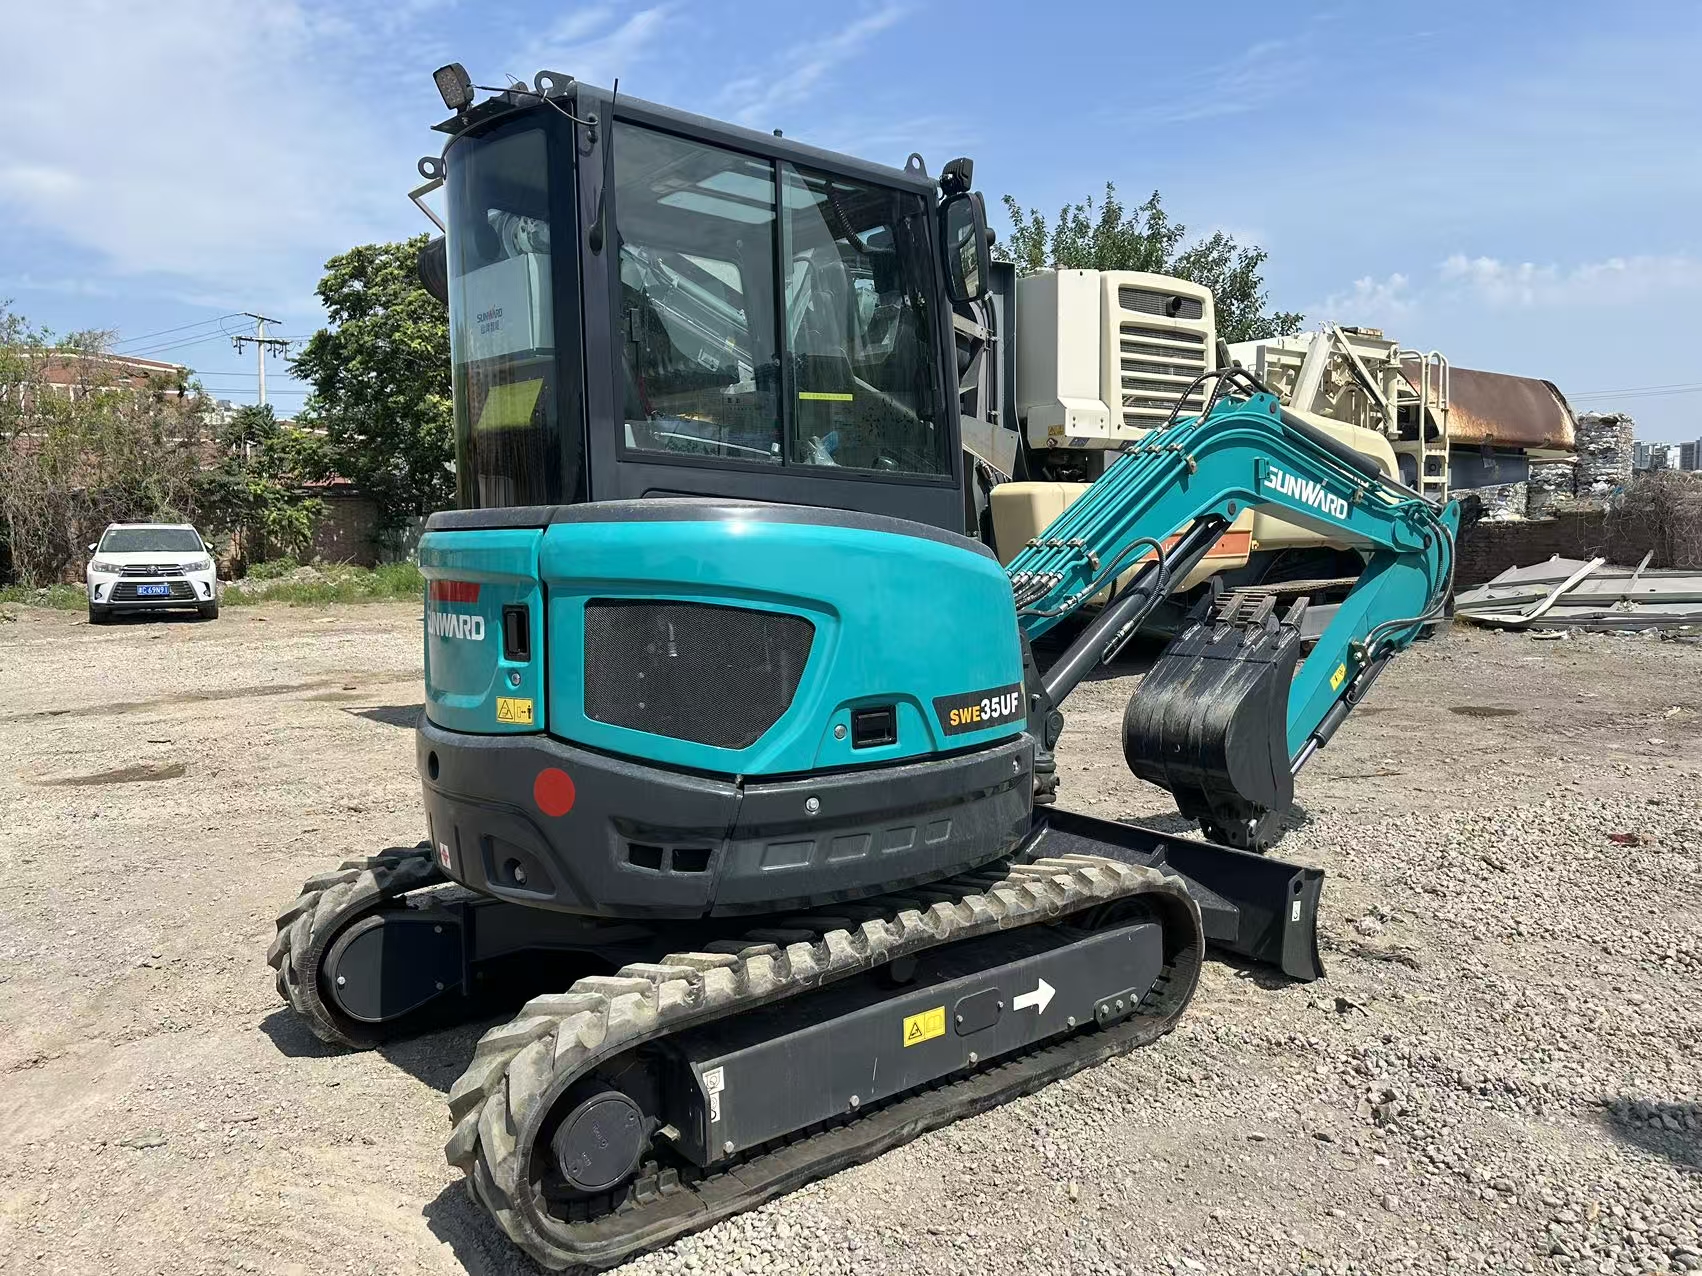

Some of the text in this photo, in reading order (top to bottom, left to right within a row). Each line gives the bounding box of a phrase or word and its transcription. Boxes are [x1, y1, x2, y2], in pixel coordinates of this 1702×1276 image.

[1264, 465, 1348, 520] SUNWARD
[427, 611, 485, 641] UNWARD
[949, 692, 1019, 726] SWE35UF
